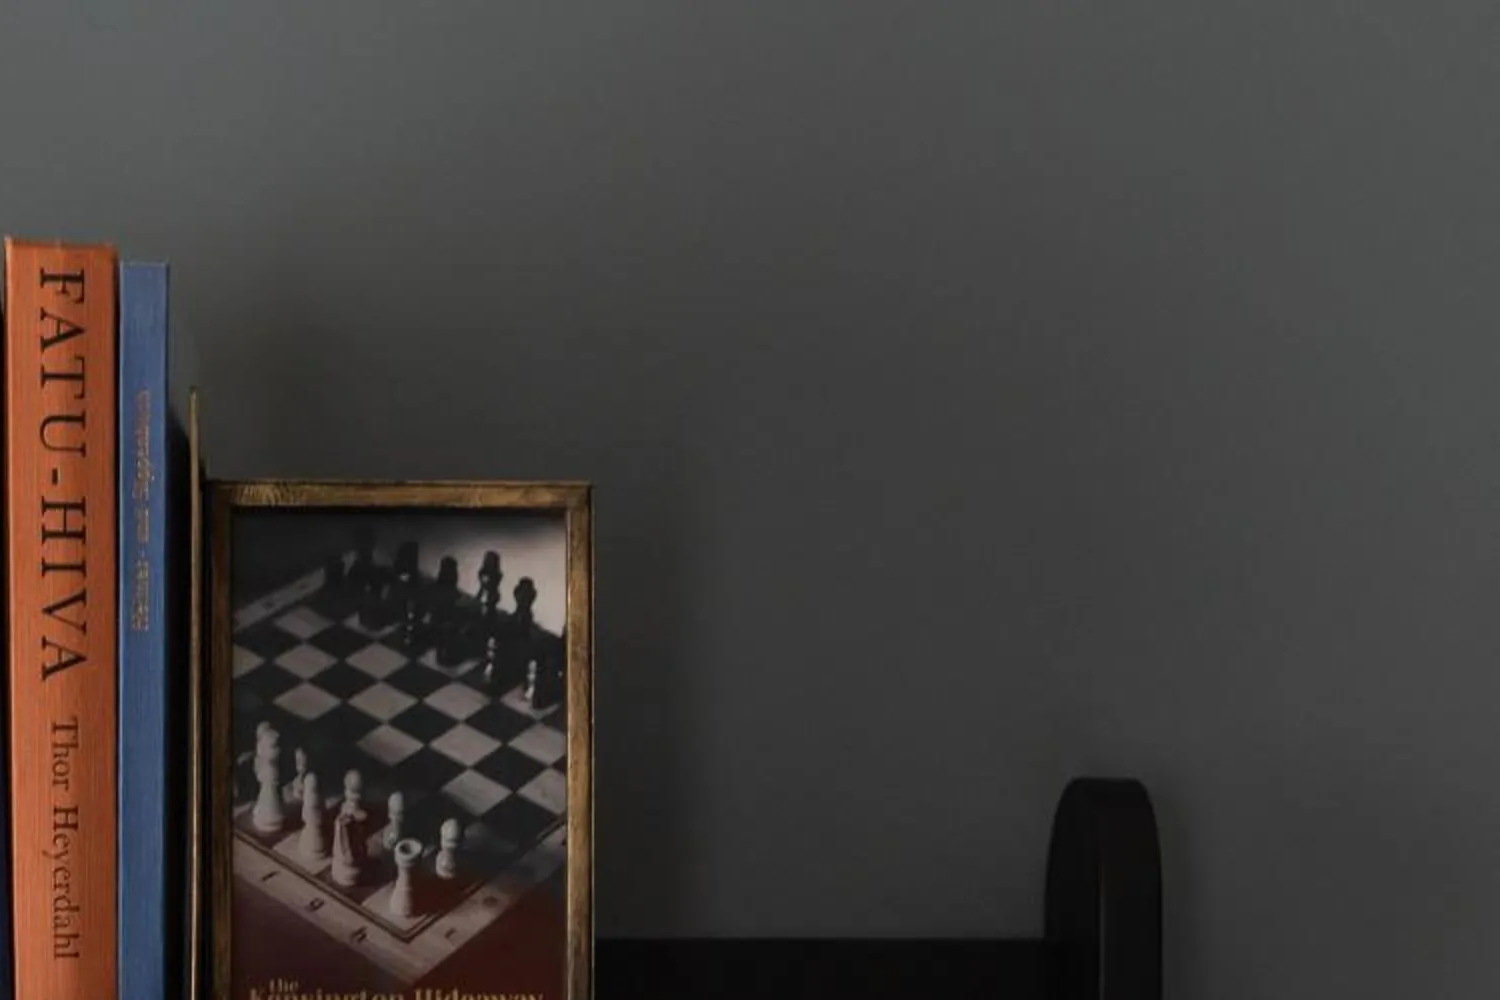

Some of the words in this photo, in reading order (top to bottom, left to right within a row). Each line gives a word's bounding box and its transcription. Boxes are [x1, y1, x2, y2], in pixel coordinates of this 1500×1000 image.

[39, 268, 88, 681] FATU-HIVA
[51, 716, 80, 791] Thor
[42, 806, 81, 960] Heyerdahl
[268, 977, 299, 993] the
